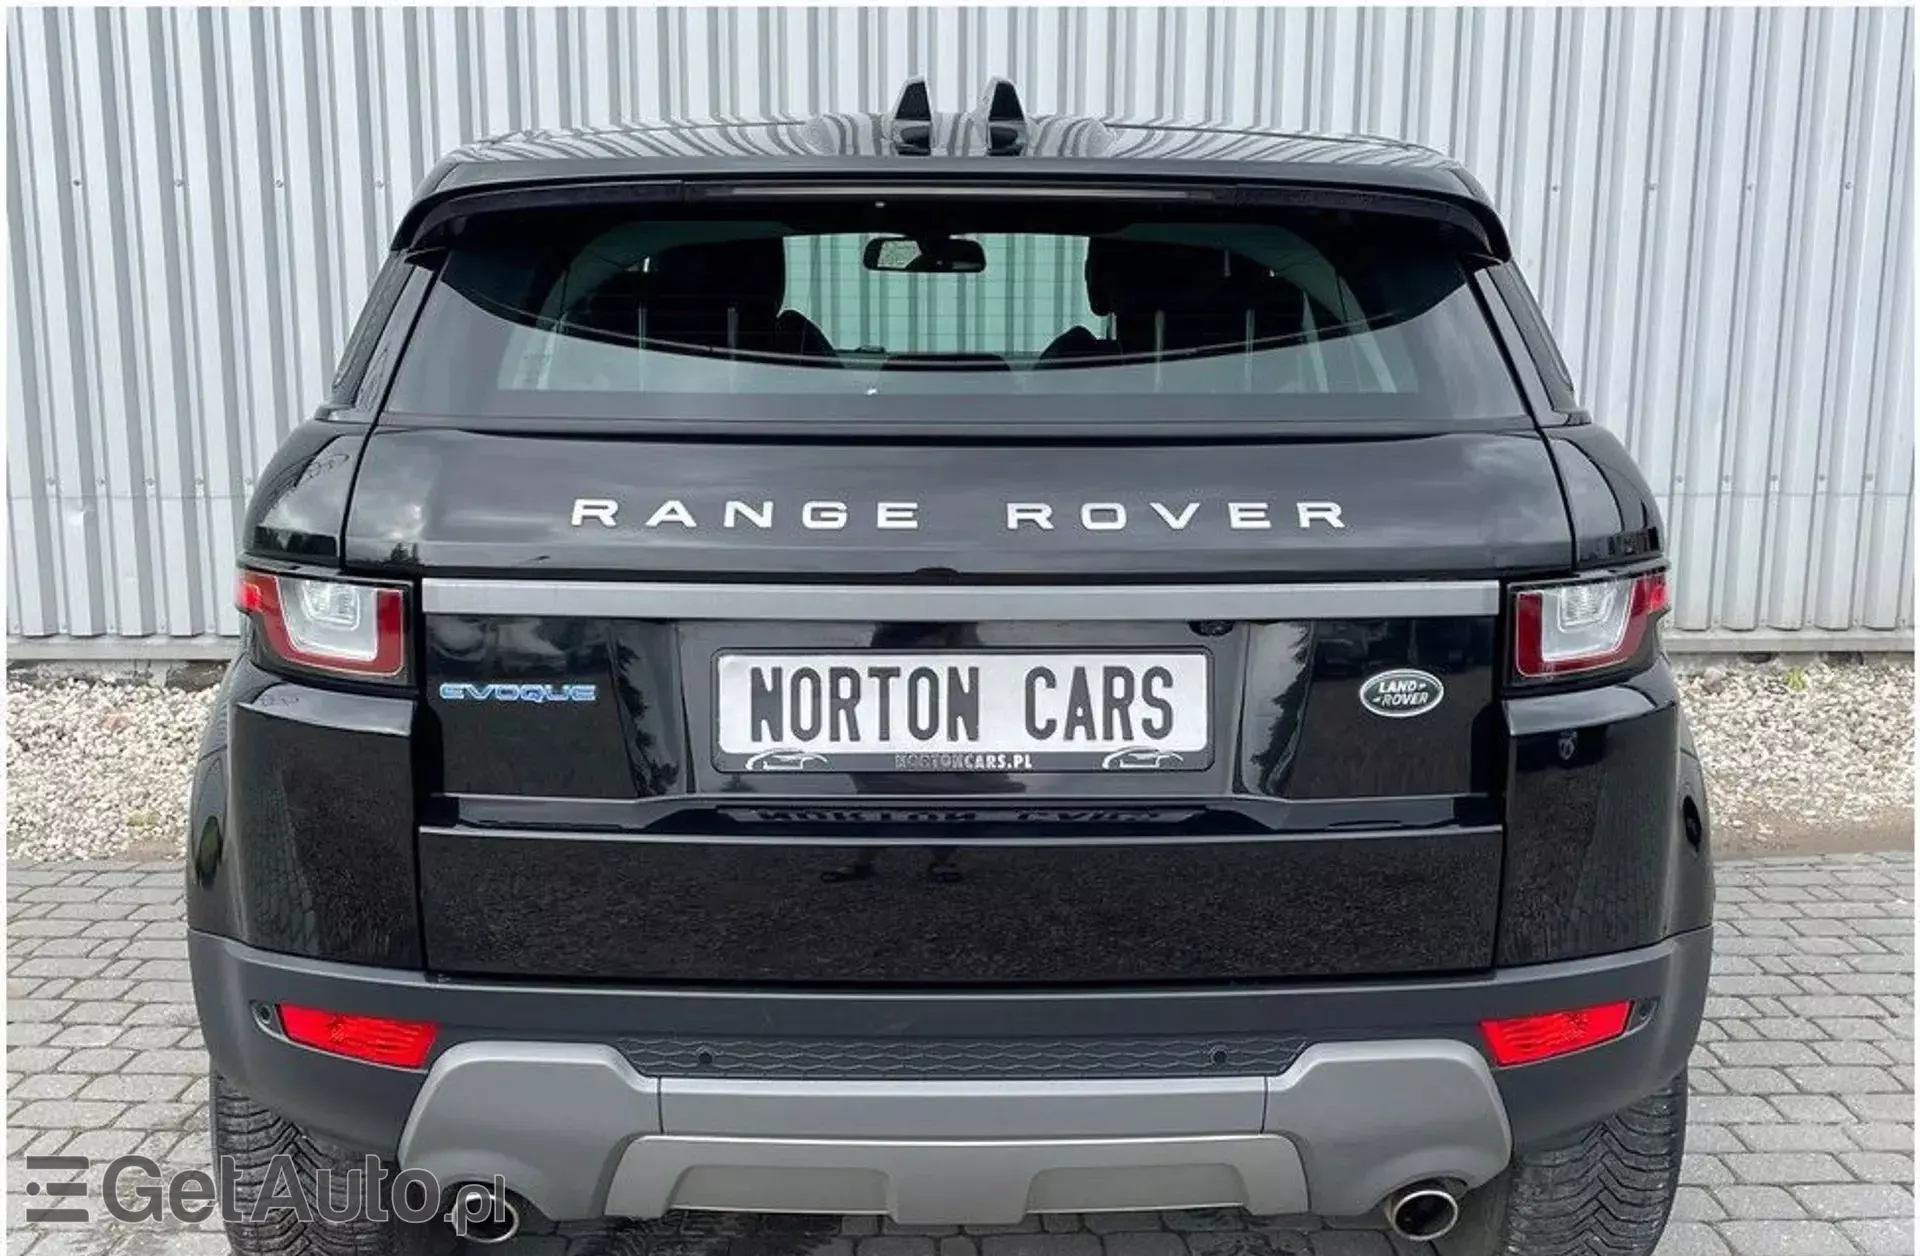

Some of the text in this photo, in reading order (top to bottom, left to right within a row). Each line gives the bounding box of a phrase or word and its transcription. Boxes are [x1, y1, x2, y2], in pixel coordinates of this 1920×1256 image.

[571, 498, 1347, 530] RANGE ROVER
[439, 682, 597, 703] EVOQUE
[1379, 680, 1417, 693] LAND
[750, 666, 1174, 742] NORTON CARS
[1382, 692, 1428, 707] ROVER
